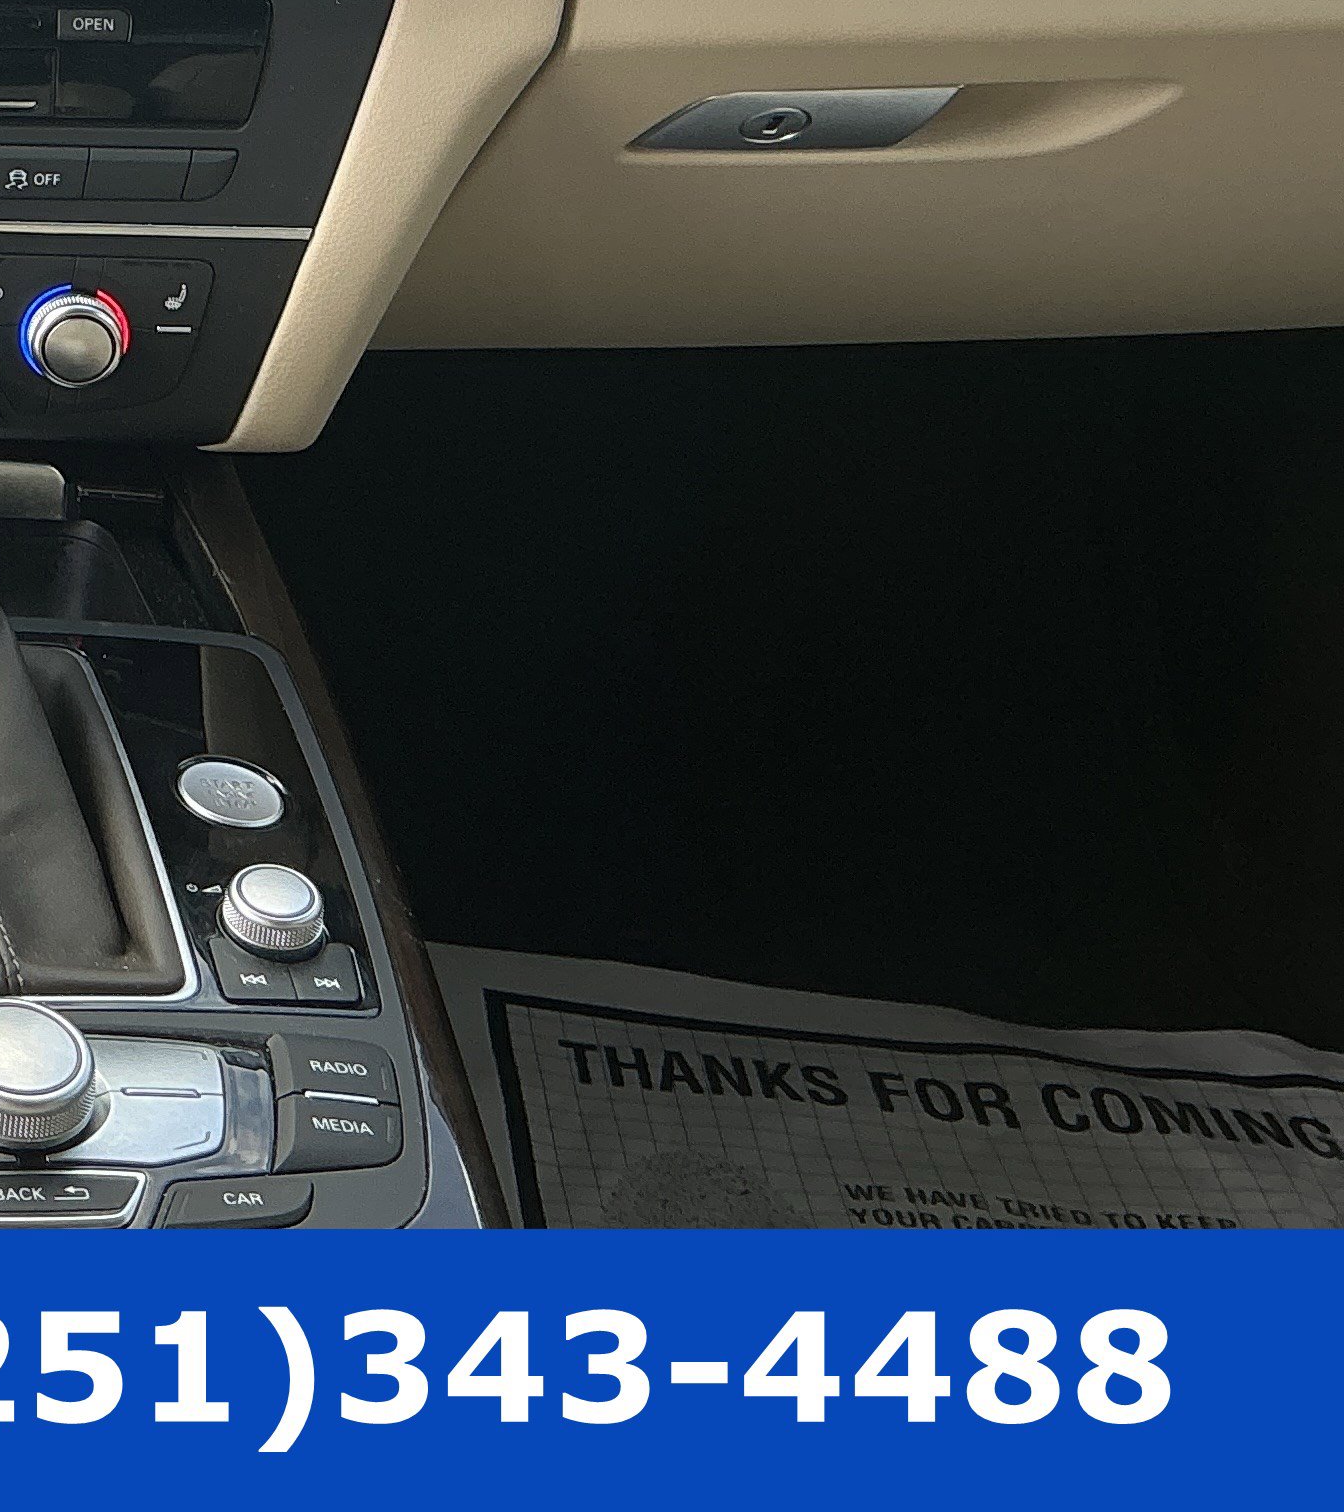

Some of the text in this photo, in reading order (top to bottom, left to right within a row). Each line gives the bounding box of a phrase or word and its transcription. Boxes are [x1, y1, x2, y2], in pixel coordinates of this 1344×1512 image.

[72, 16, 114, 31] OPEN
[33, 172, 61, 186] OFF
[309, 1058, 368, 1077] RADIO
[558, 1038, 1344, 1160] THANKS FOR COMING
[312, 1116, 375, 1137] MEDIA
[222, 1191, 265, 1207] CAR
[844, 1184, 896, 1202] WE
[903, 1186, 990, 1211] HAVE
[995, 1195, 1093, 1227] TRIED
[1100, 1209, 1148, 1229] TO
[849, 1207, 944, 1229] YOUR
